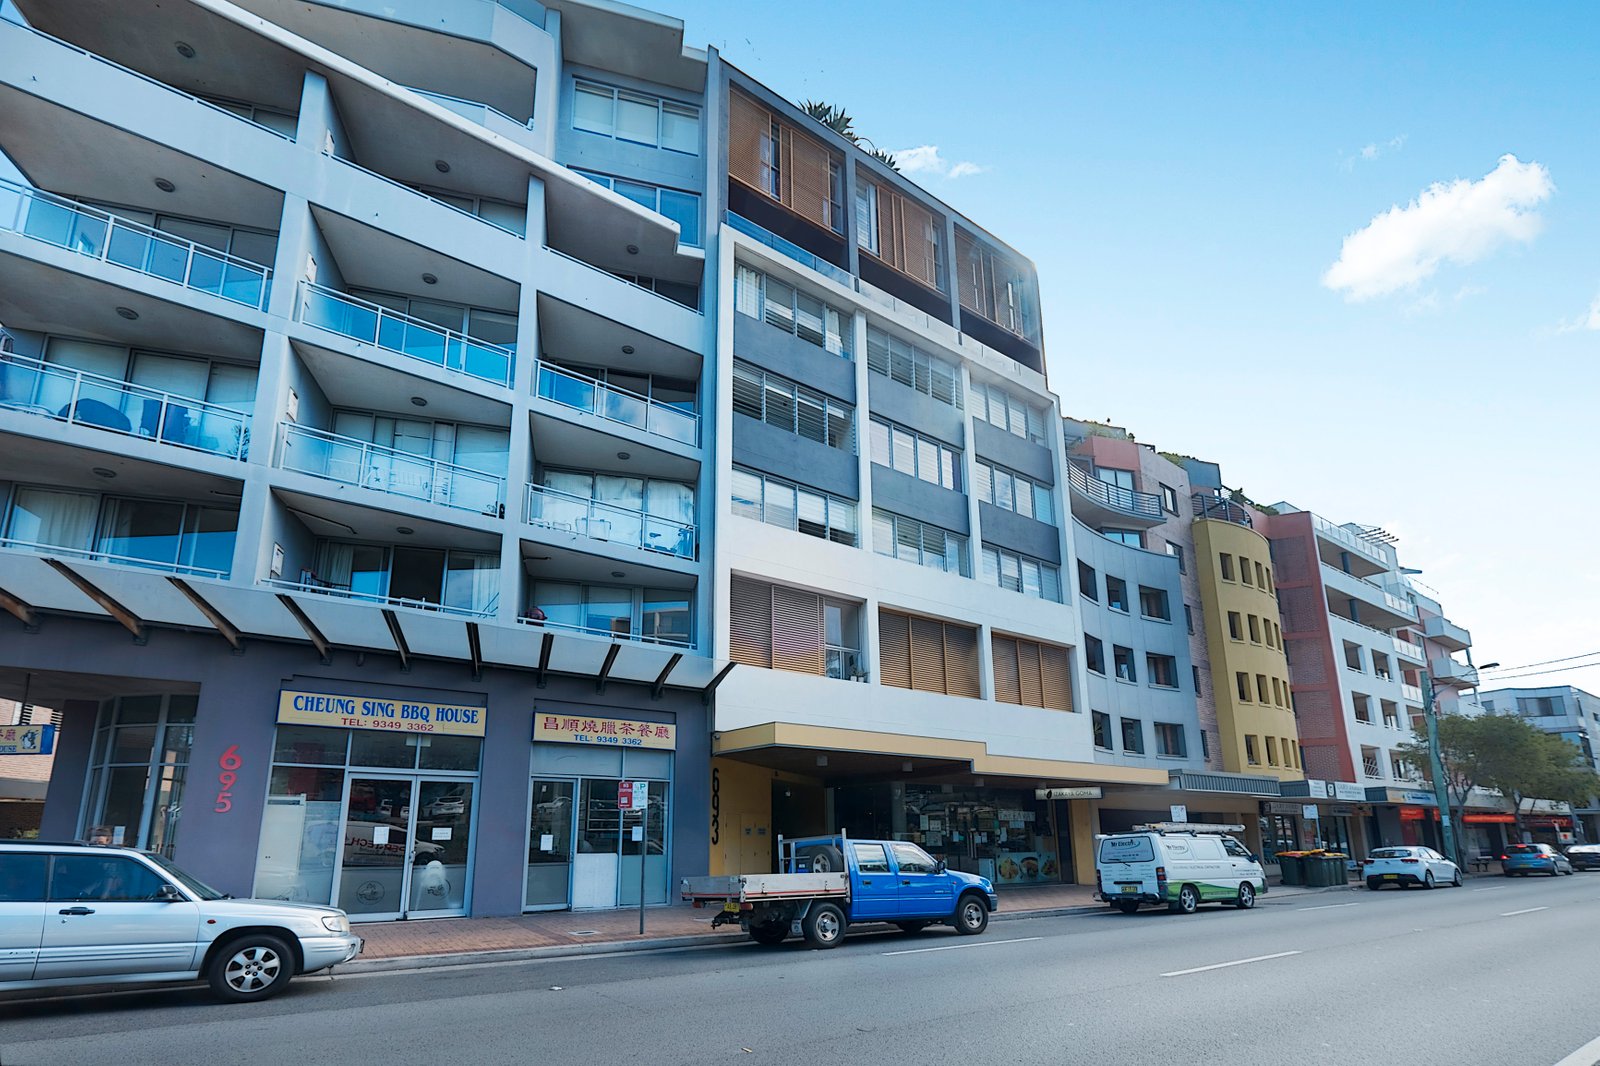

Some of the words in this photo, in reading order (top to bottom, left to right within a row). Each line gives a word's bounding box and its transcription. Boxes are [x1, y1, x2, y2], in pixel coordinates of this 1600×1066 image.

[293, 695, 355, 715] CHEUNG
[361, 701, 395, 718] SING
[400, 704, 430, 723] BBQ
[436, 707, 479, 724] HOUSE
[341, 717, 367, 727] TEL:
[372, 720, 401, 729] 9349
[407, 722, 434, 732] 3362
[574, 734, 593, 742] TEL:
[596, 735, 618, 744] 9349
[622, 737, 642, 746] 3362
[213, 744, 243, 814] 695
[711, 767, 720, 846] 693
